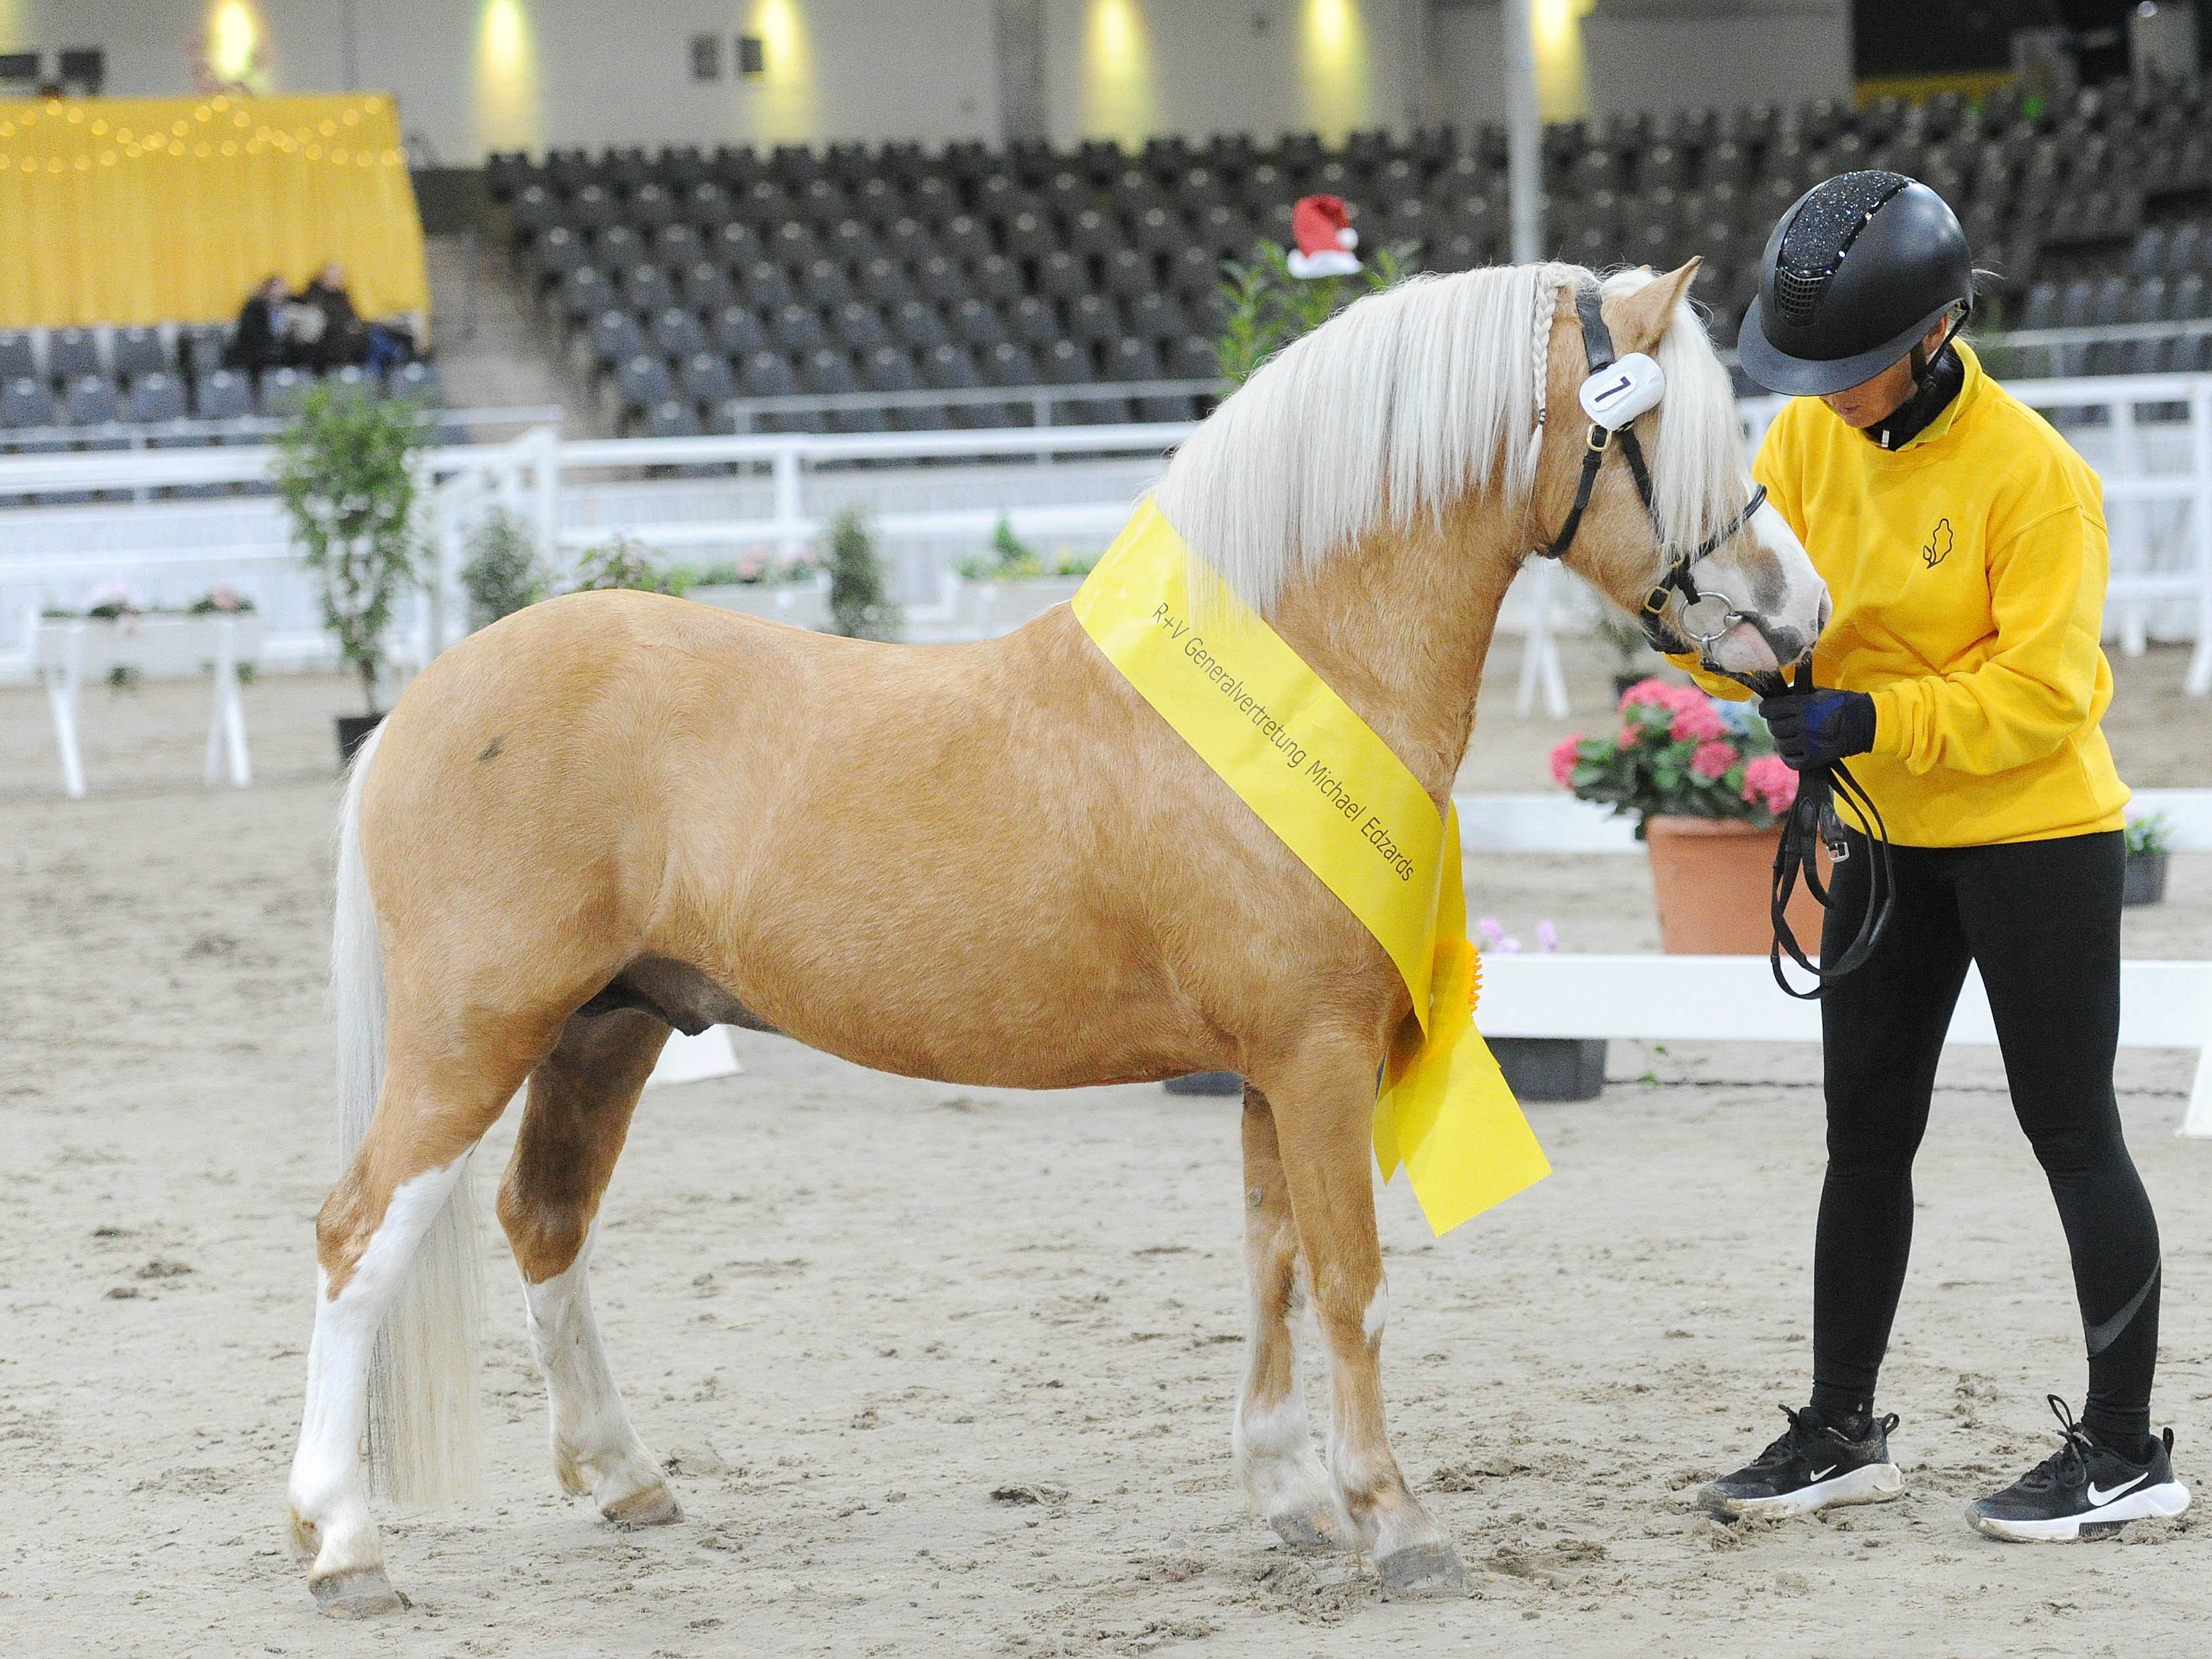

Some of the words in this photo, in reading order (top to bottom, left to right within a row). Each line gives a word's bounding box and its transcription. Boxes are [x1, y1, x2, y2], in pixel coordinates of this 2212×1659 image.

[1152, 601, 1189, 639] R+V
[1185, 637, 1306, 769] Generalvertretung
[1305, 759, 1367, 823] Michael
[1360, 816, 1415, 882] Edzards
